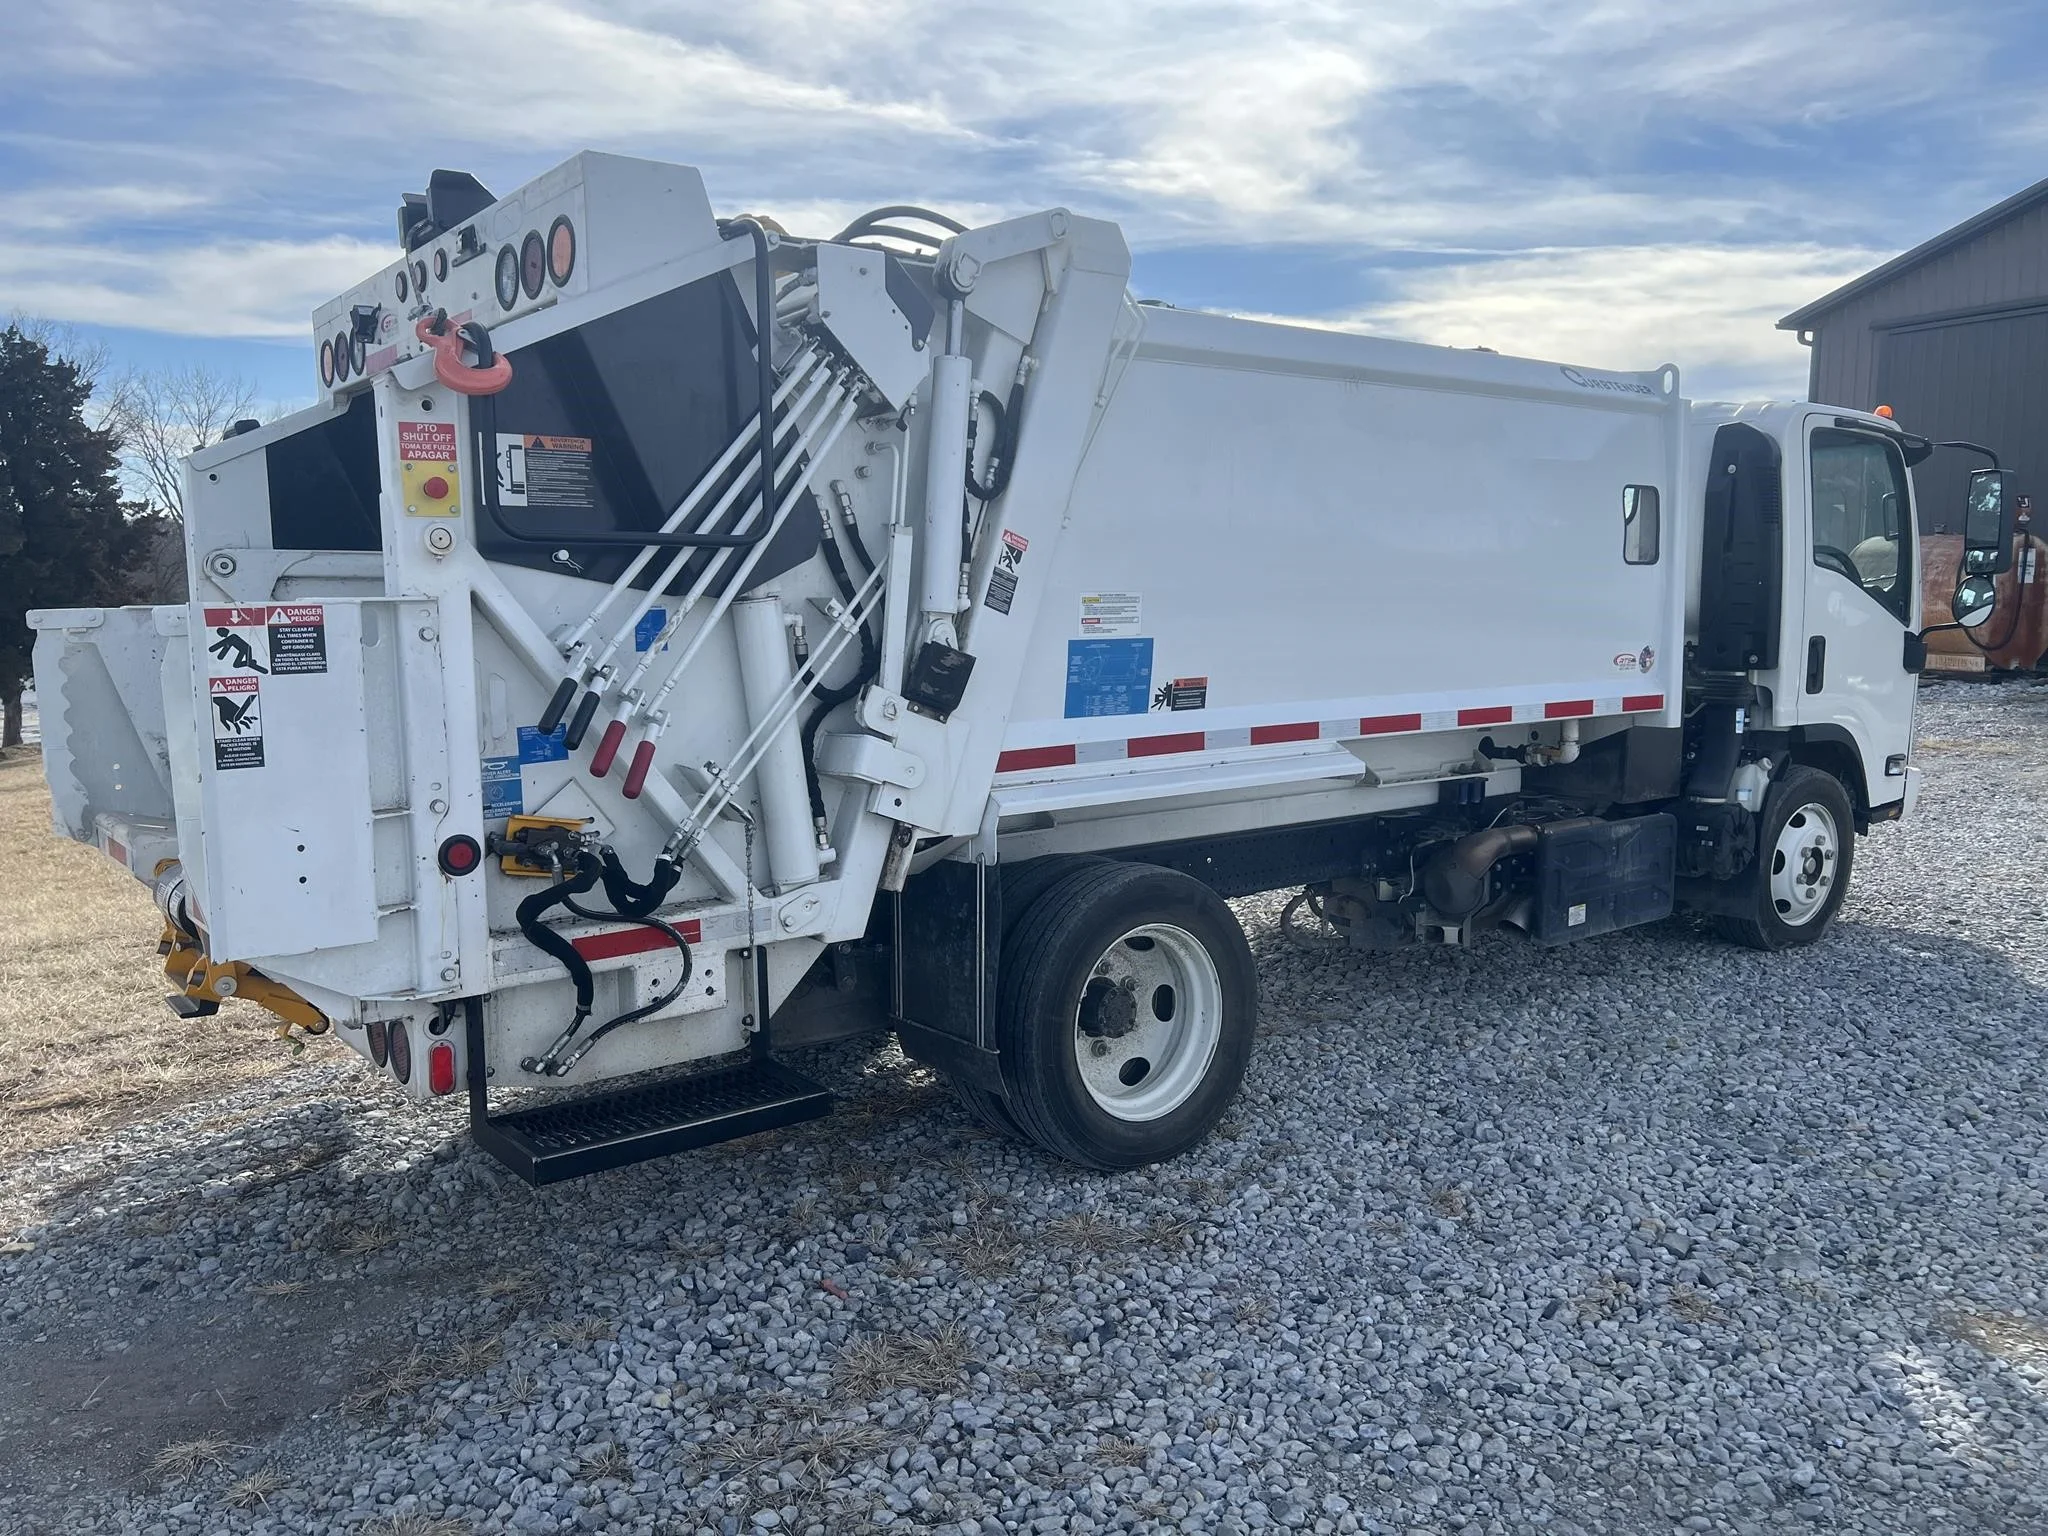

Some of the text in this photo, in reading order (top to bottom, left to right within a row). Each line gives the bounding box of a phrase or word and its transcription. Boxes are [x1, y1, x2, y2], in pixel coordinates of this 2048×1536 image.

[416, 424, 437, 433] PTO
[402, 432, 452, 442] SHUT OFF
[408, 450, 450, 460] APAGAR
[287, 608, 322, 616] DANGER
[225, 677, 257, 685] DANGER
[228, 684, 256, 692] PELIGRO
